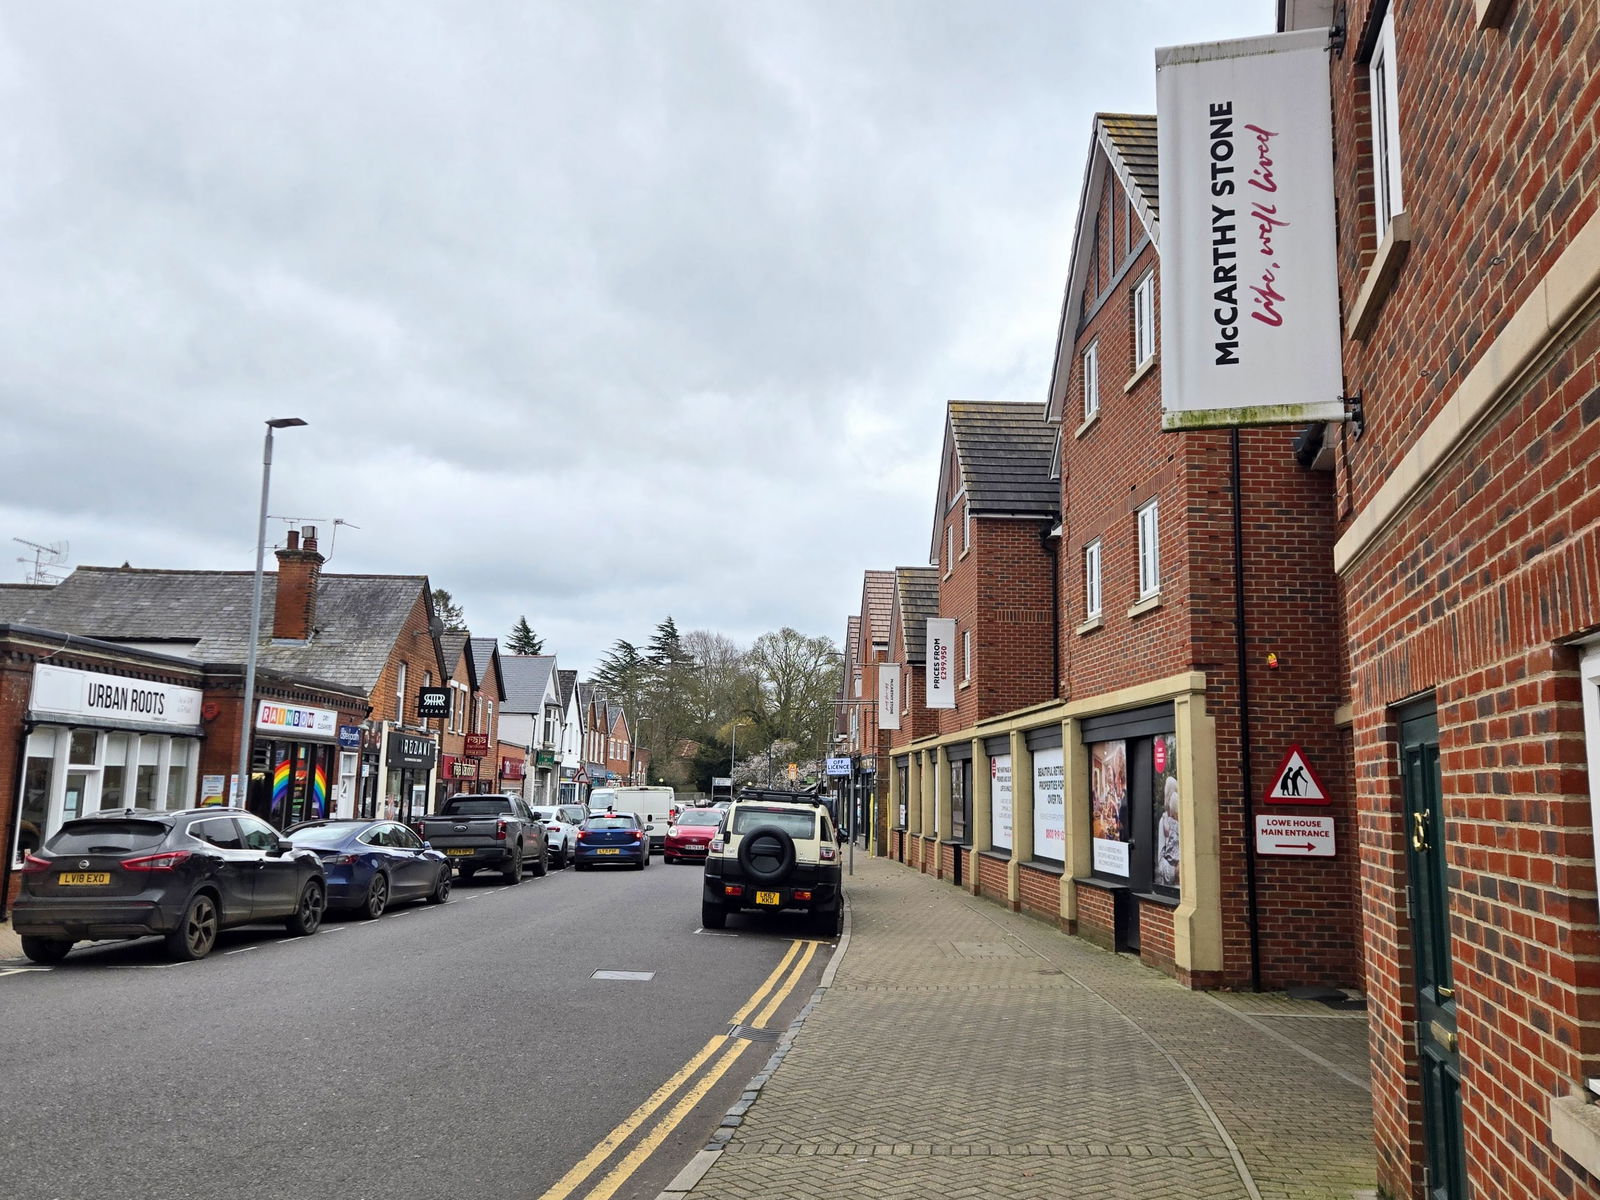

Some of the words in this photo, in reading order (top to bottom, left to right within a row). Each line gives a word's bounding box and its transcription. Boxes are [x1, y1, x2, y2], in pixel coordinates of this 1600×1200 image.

[1209, 100, 1235, 197] STONE
[1244, 123, 1280, 193] lived
[1251, 201, 1291, 256] well
[1212, 203, 1239, 366] McCARTHY
[88, 682, 128, 711] URBAN
[130, 688, 165, 715] ROOTS
[262, 706, 315, 728] RAINBOW
[404, 740, 430, 756] REZAKI
[64, 874, 84, 883] LV18
